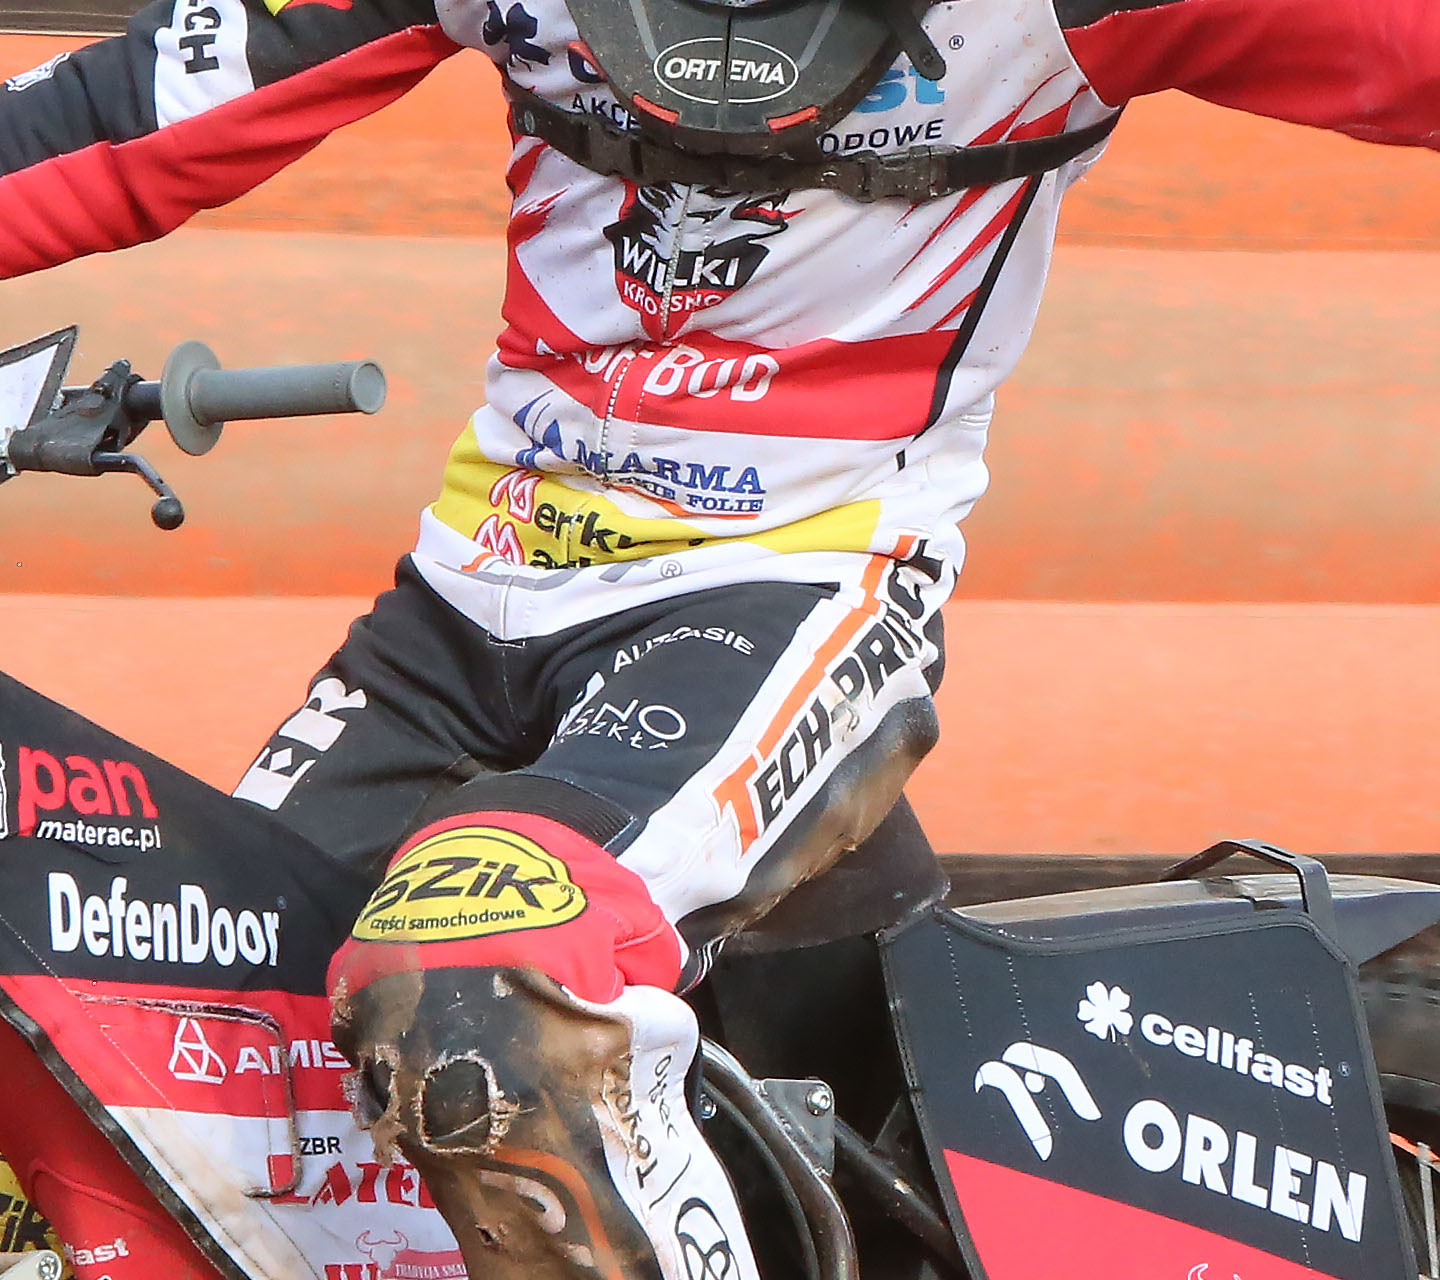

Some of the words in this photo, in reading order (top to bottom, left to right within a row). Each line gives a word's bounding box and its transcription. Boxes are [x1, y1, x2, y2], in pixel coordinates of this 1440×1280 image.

[664, 57, 787, 87] ORTEMA
[621, 235, 741, 295] WILKI
[686, 492, 764, 513] FOLIE
[17, 743, 160, 836] pan
[35, 817, 162, 850] materac.pl
[47, 871, 281, 967] DefenDoor
[361, 854, 555, 922] SZiK
[407, 907, 527, 932] samochodowe
[1140, 1010, 1334, 1107] cellfast
[1123, 1099, 1369, 1243] ORLEN
